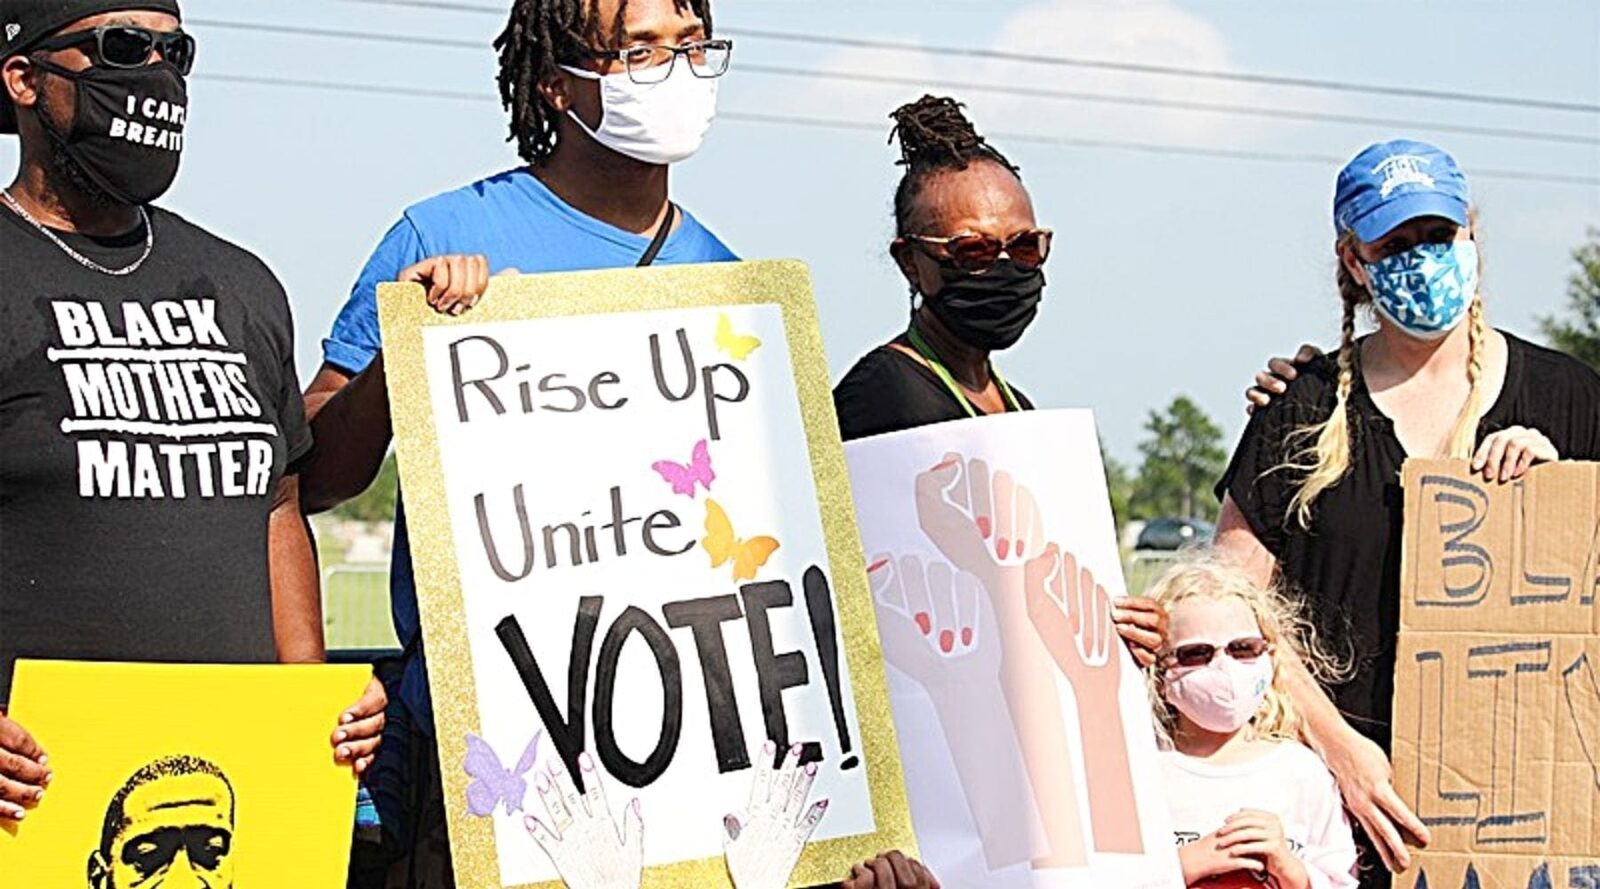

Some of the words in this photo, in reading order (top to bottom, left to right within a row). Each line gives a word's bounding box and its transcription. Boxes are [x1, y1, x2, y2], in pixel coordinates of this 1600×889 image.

[126, 95, 136, 115] I
[51, 298, 229, 347] BLACK
[61, 361, 262, 420] MOTHERS
[449, 335, 629, 423] Rise
[649, 328, 751, 441] Up
[77, 439, 273, 498] MATTER
[474, 483, 697, 582] Unite
[494, 564, 860, 795] VOTE!
